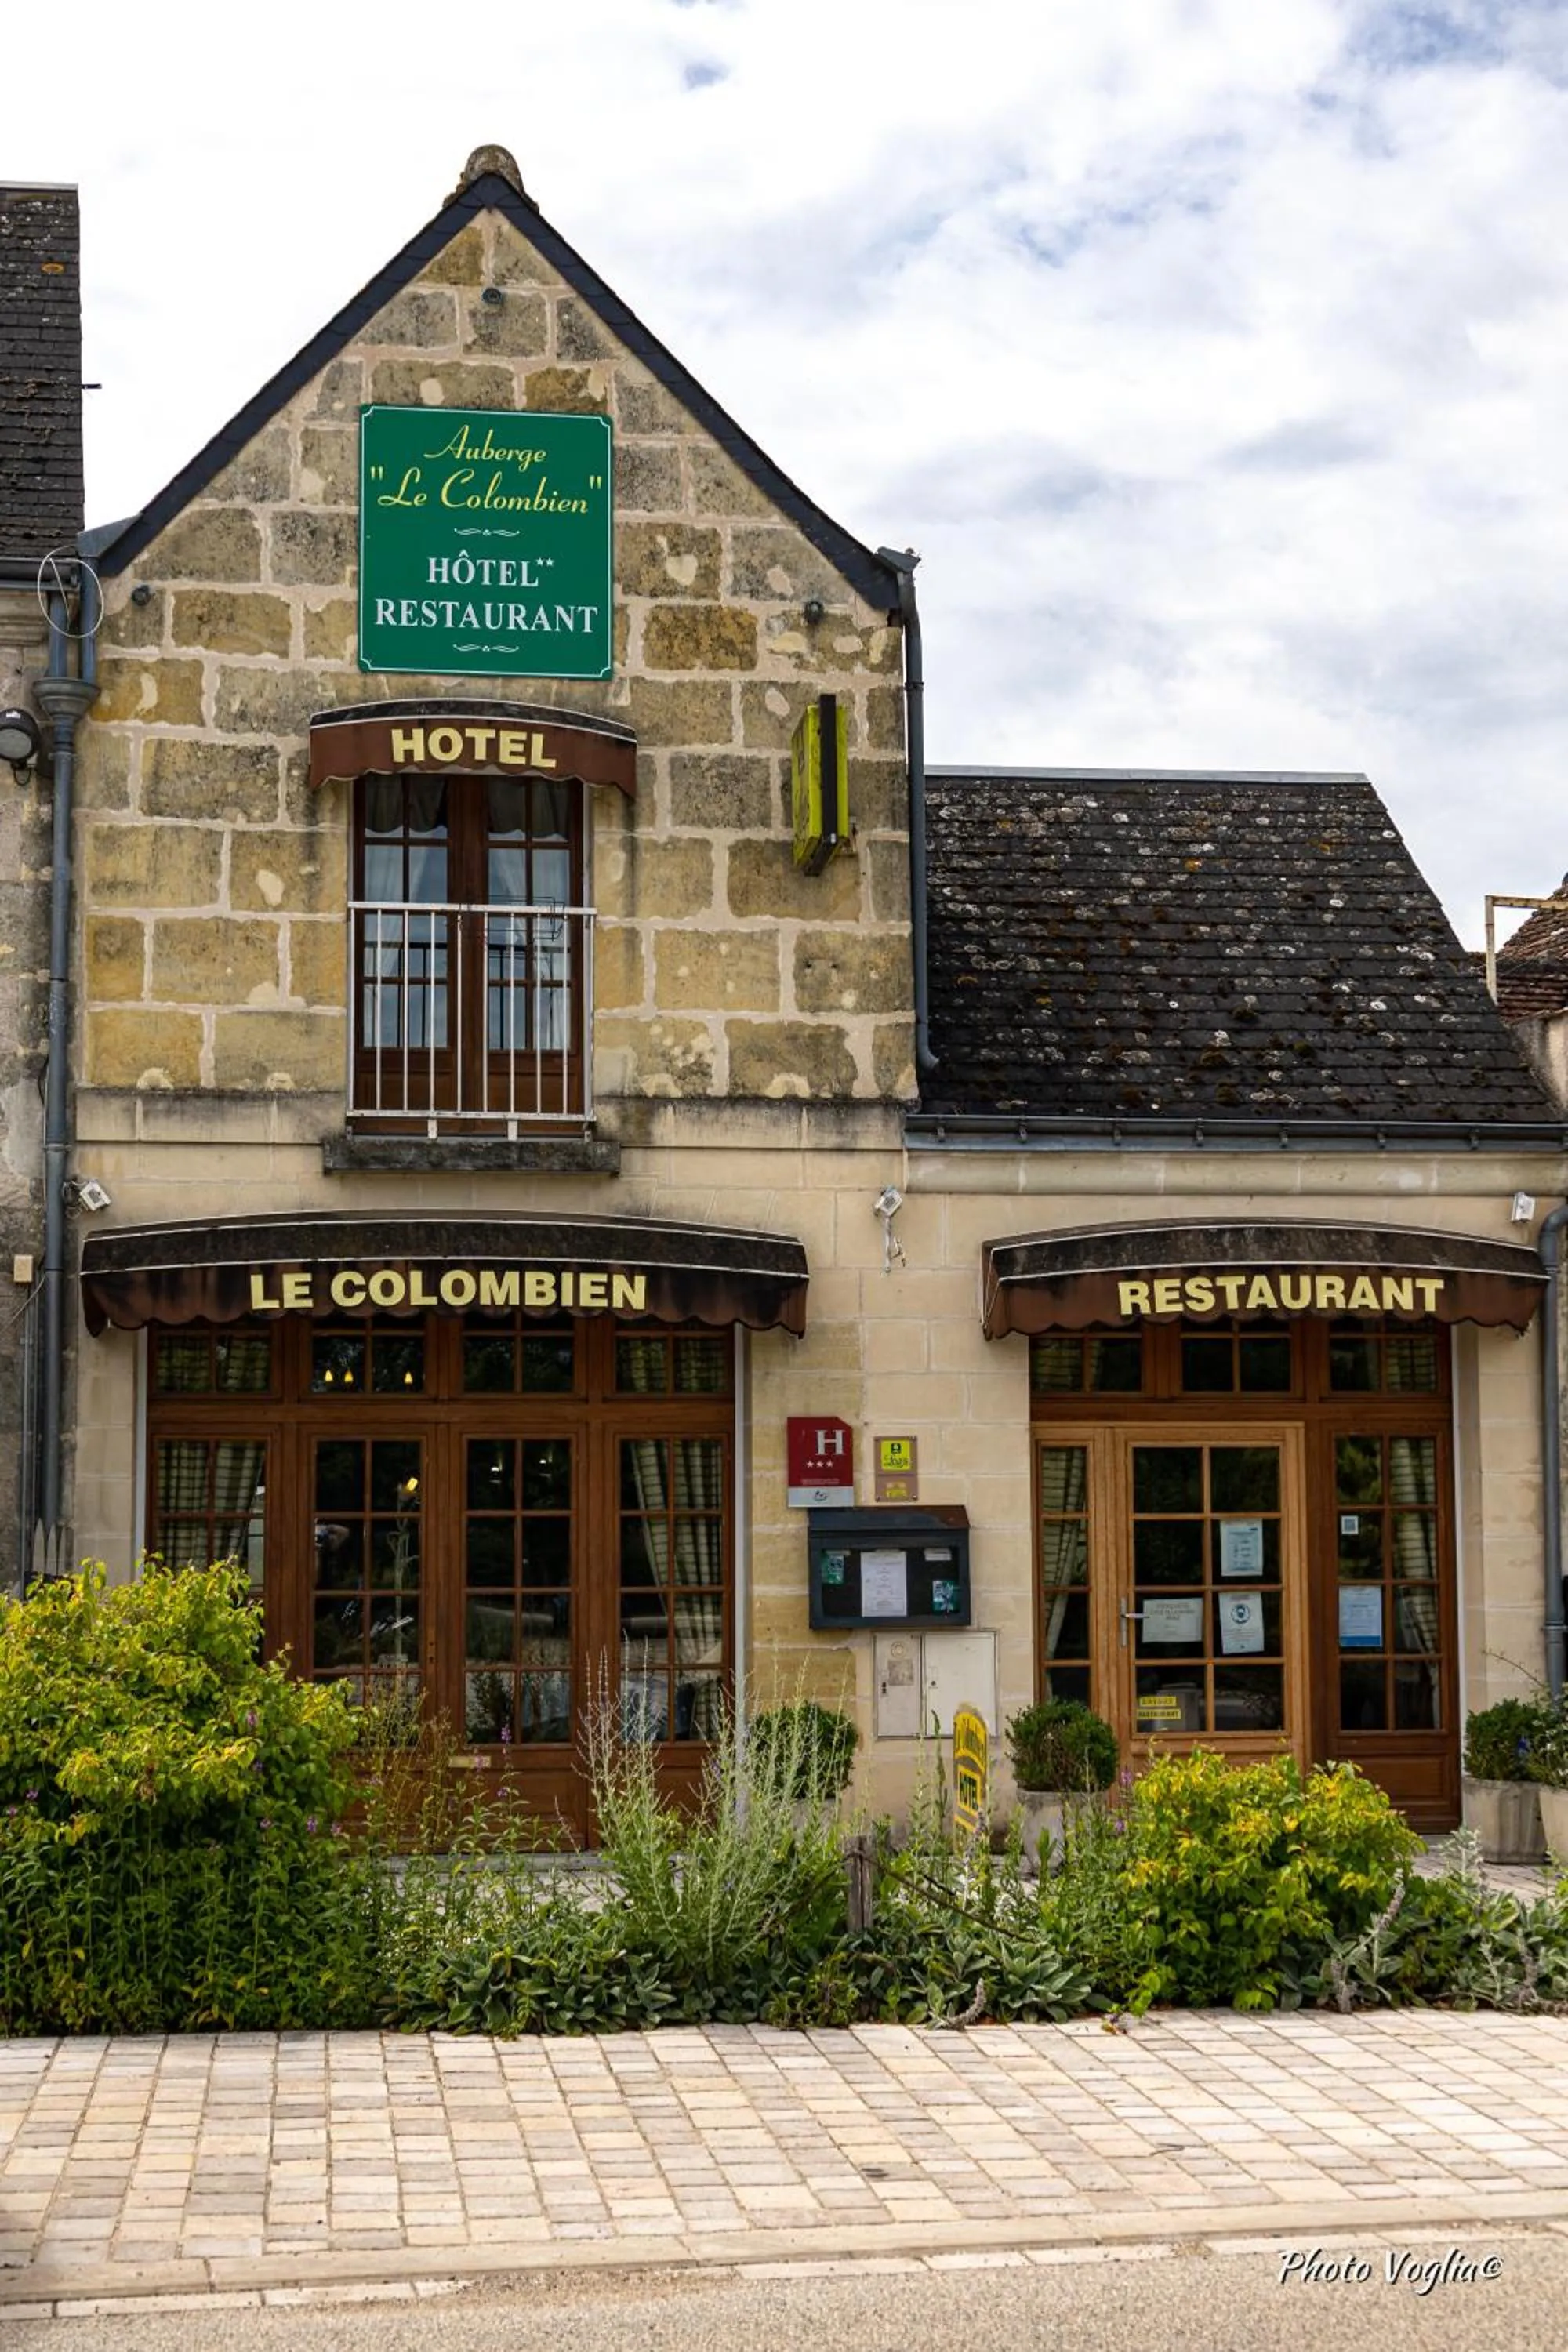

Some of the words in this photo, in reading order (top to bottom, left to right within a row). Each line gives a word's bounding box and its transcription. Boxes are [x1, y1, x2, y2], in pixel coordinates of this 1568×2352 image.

[424, 424, 546, 472] Auberge
[375, 598, 598, 633] RESTAURANT
[391, 727, 557, 768] HOTEL
[249, 1272, 313, 1310] LE
[330, 1269, 647, 1310] COLOMBIEN
[1117, 1274, 1445, 1316] RESTAURANT
[815, 1429, 845, 1456] H
